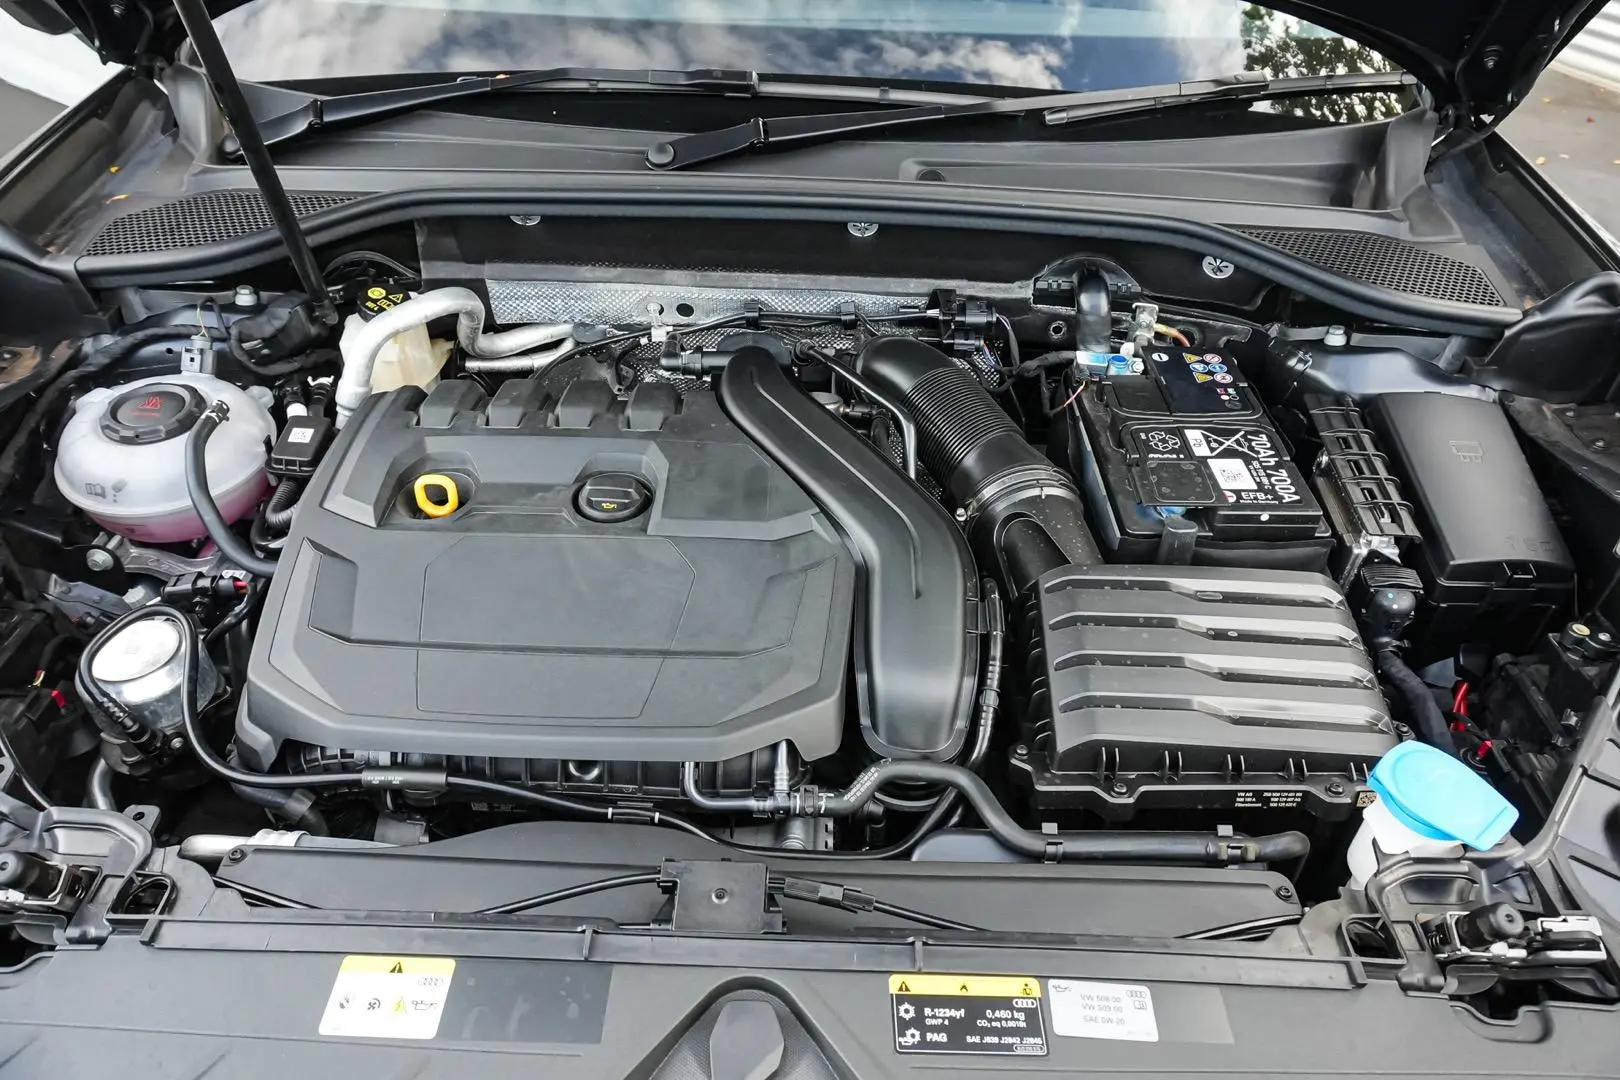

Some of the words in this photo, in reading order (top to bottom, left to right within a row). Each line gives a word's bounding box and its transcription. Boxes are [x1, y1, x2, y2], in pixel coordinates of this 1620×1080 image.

[1247, 434, 1279, 466] 70Ah
[1266, 469, 1301, 503] 700A
[1241, 491, 1274, 500] EFB+
[1080, 993, 1094, 1002] VW
[1081, 1003, 1095, 1011] VW
[924, 1007, 965, 1019] R-1234yf
[986, 1010, 1011, 1019] 0,460
[1013, 1010, 1025, 1021] kg
[925, 1018, 943, 1026] GWP
[1083, 1015, 1099, 1024] SAE
[926, 1032, 948, 1043] PAG
[966, 1035, 981, 1043] SAE
